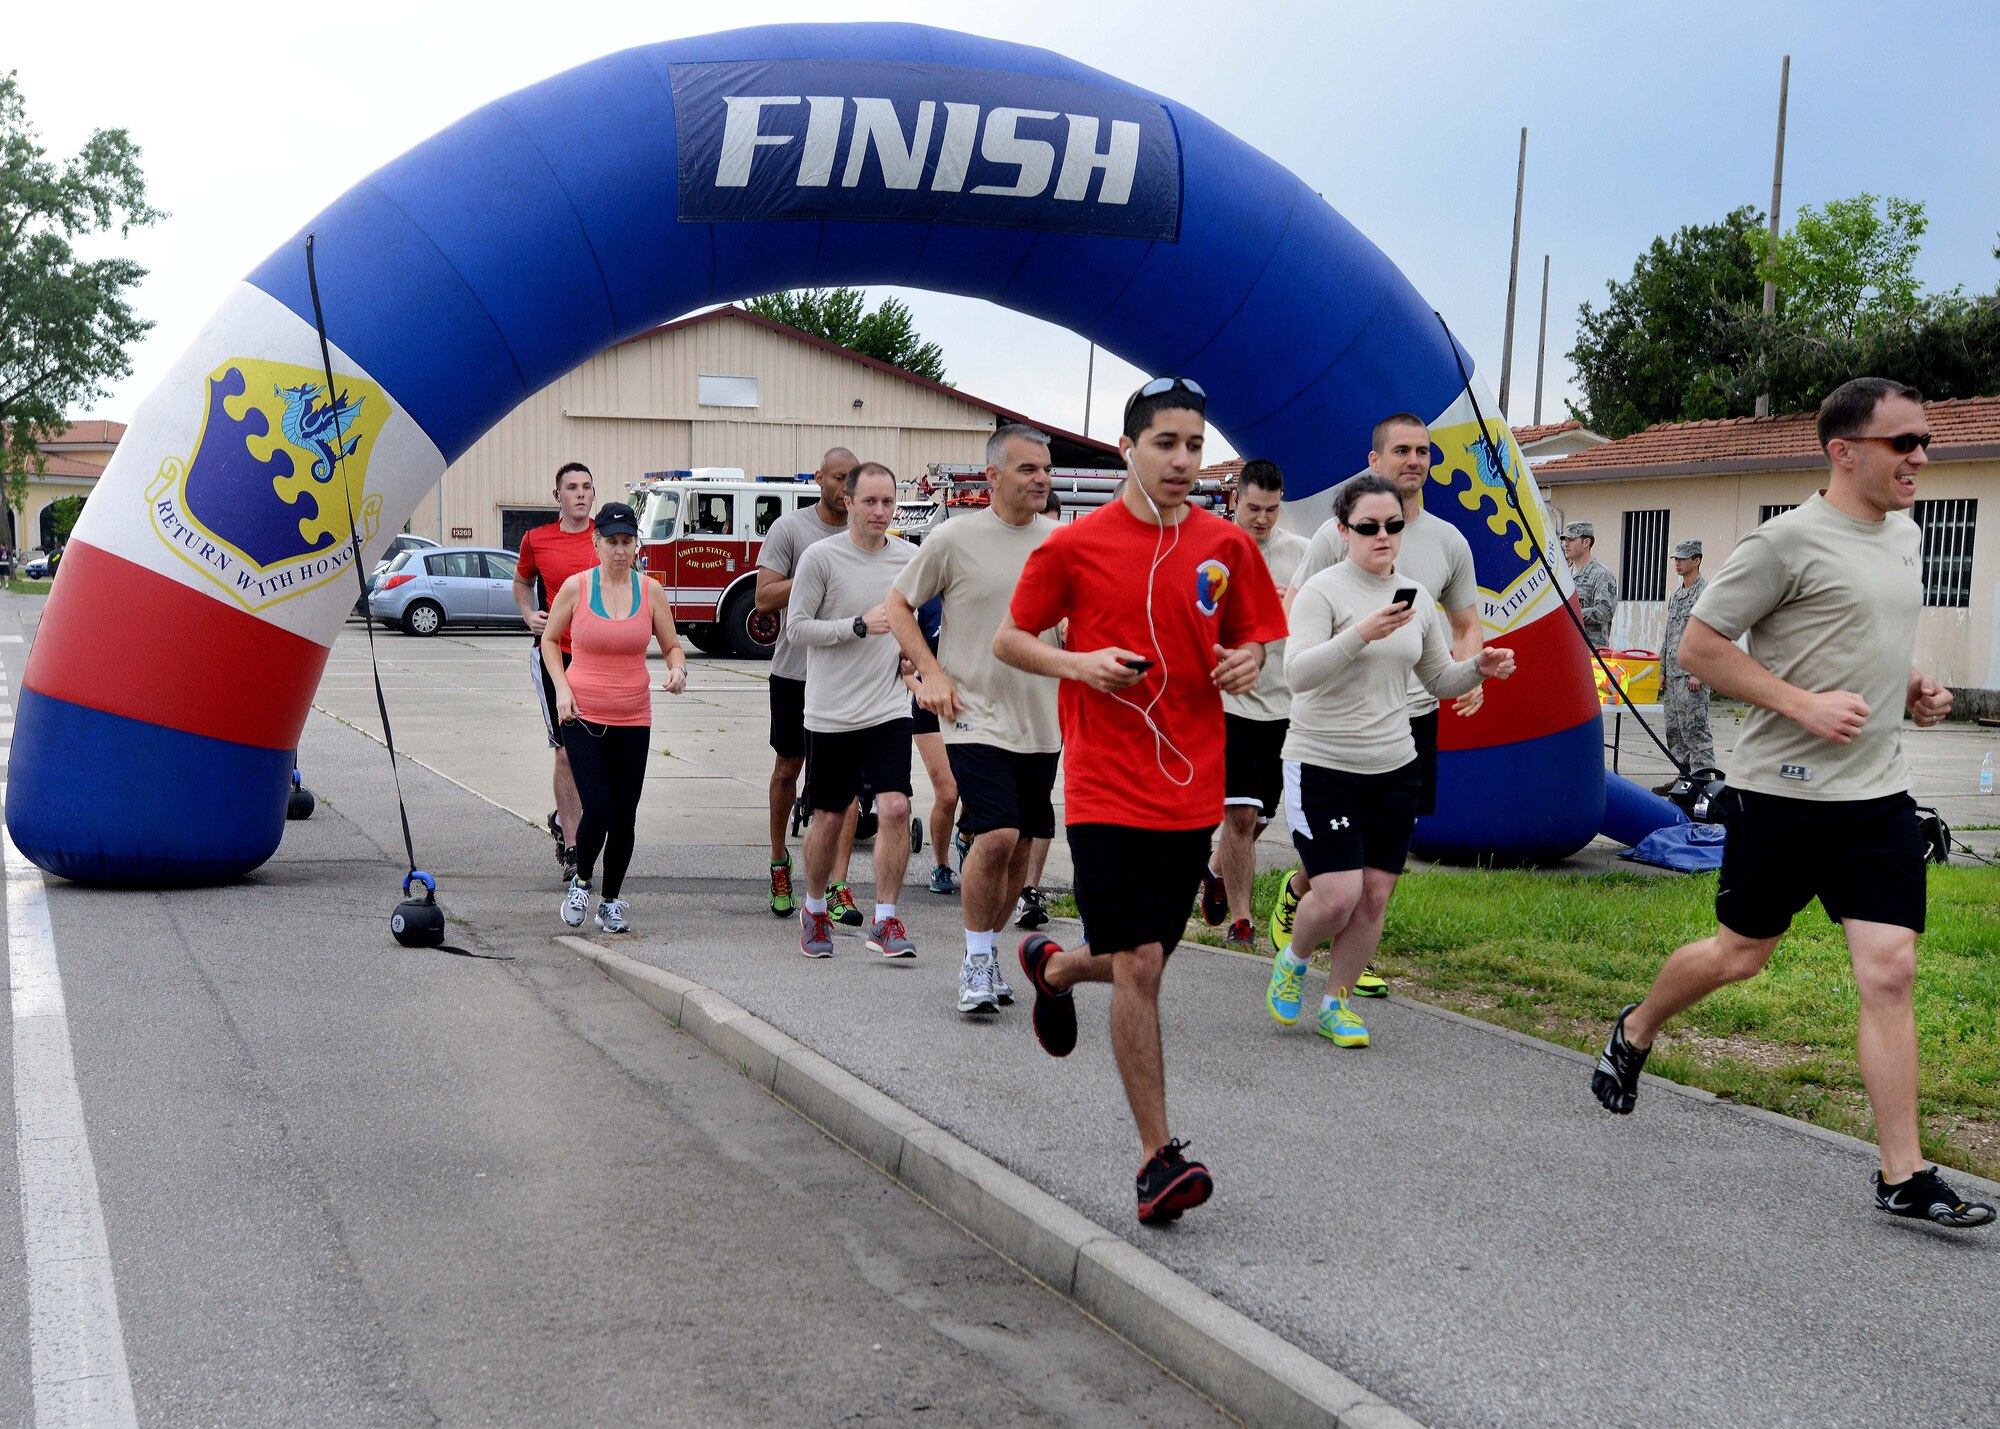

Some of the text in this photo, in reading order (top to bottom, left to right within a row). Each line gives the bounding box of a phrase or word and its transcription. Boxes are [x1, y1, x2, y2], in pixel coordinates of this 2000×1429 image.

[715, 96, 1140, 205] FINISH
[157, 499, 233, 571] RETURN
[236, 570, 294, 597] WITH
[678, 546, 732, 559] UNITED STATES
[686, 559, 724, 569] AIR FORCE
[1484, 588, 1528, 618] WITH
